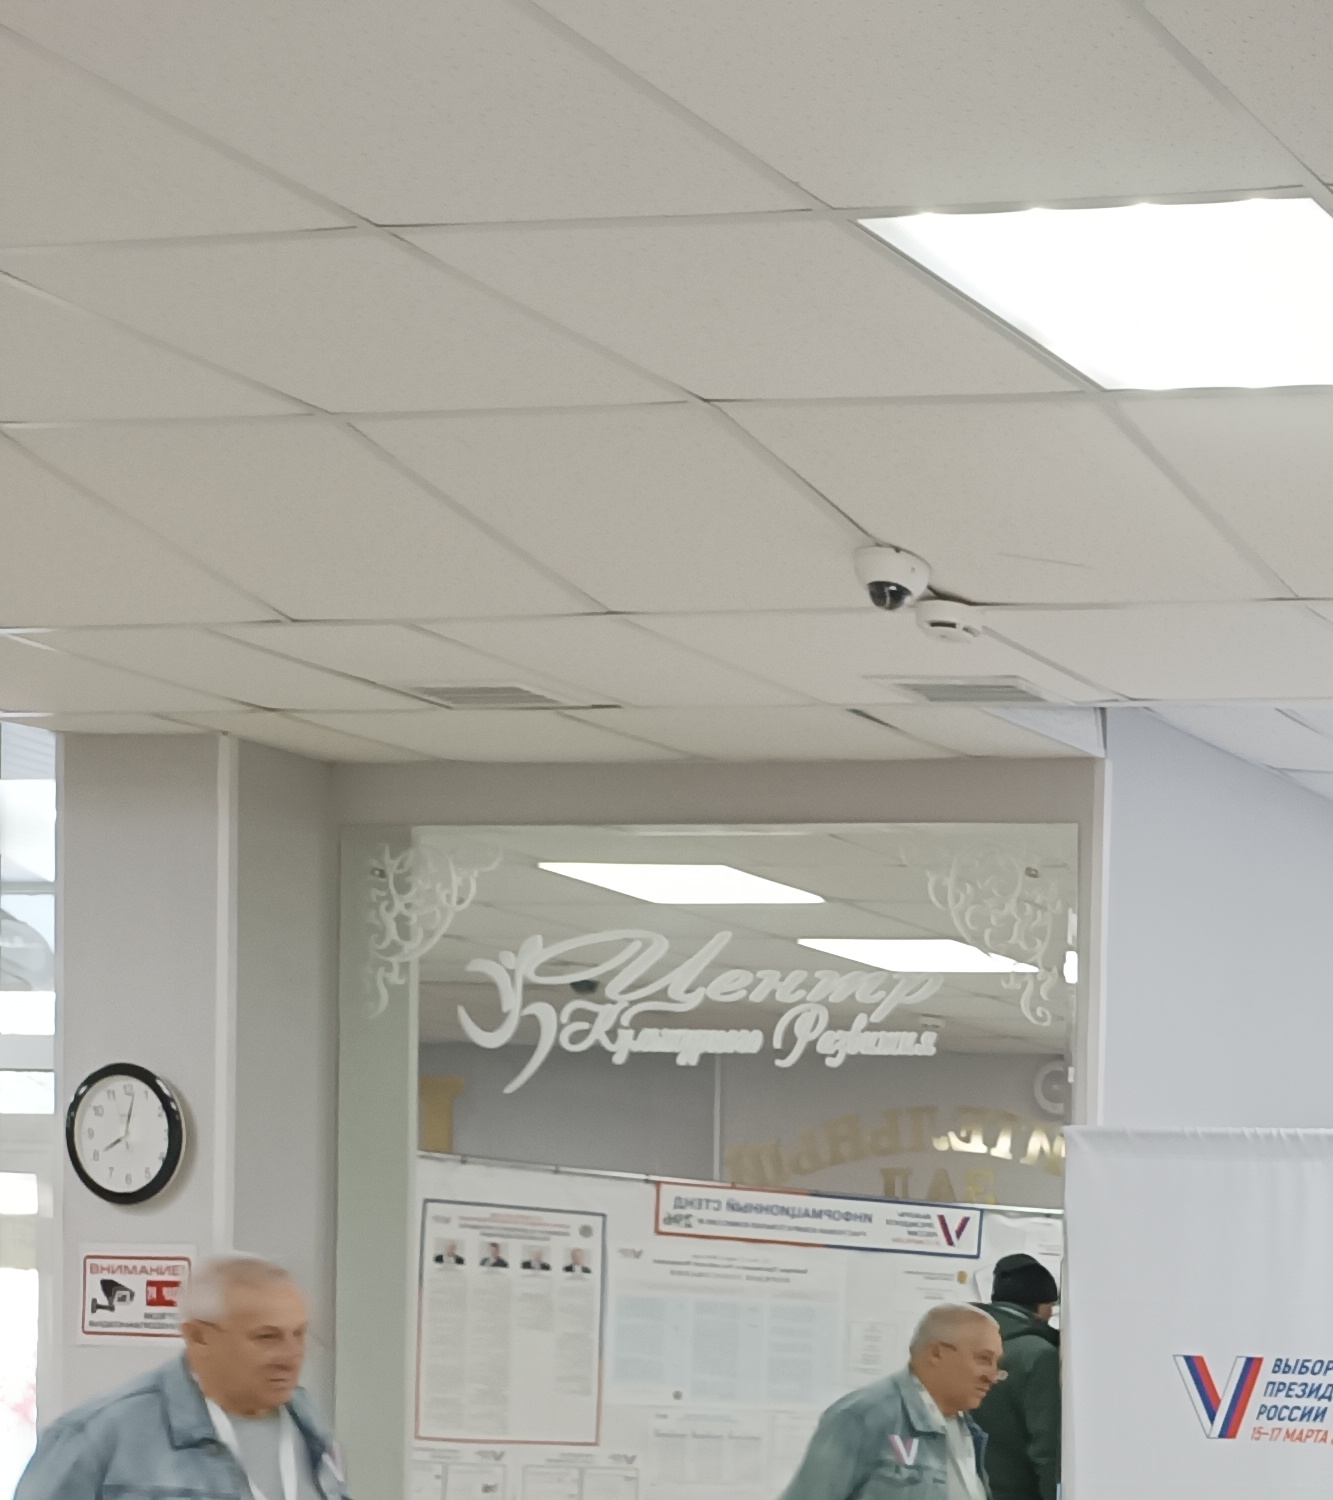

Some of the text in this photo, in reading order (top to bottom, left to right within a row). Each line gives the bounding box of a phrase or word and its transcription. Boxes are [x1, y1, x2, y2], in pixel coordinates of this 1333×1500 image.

[520, 929, 945, 1024] Центр
[1256, 1404, 1328, 1423] РОССИИ
[1283, 1427, 1329, 1444] МАРТА
